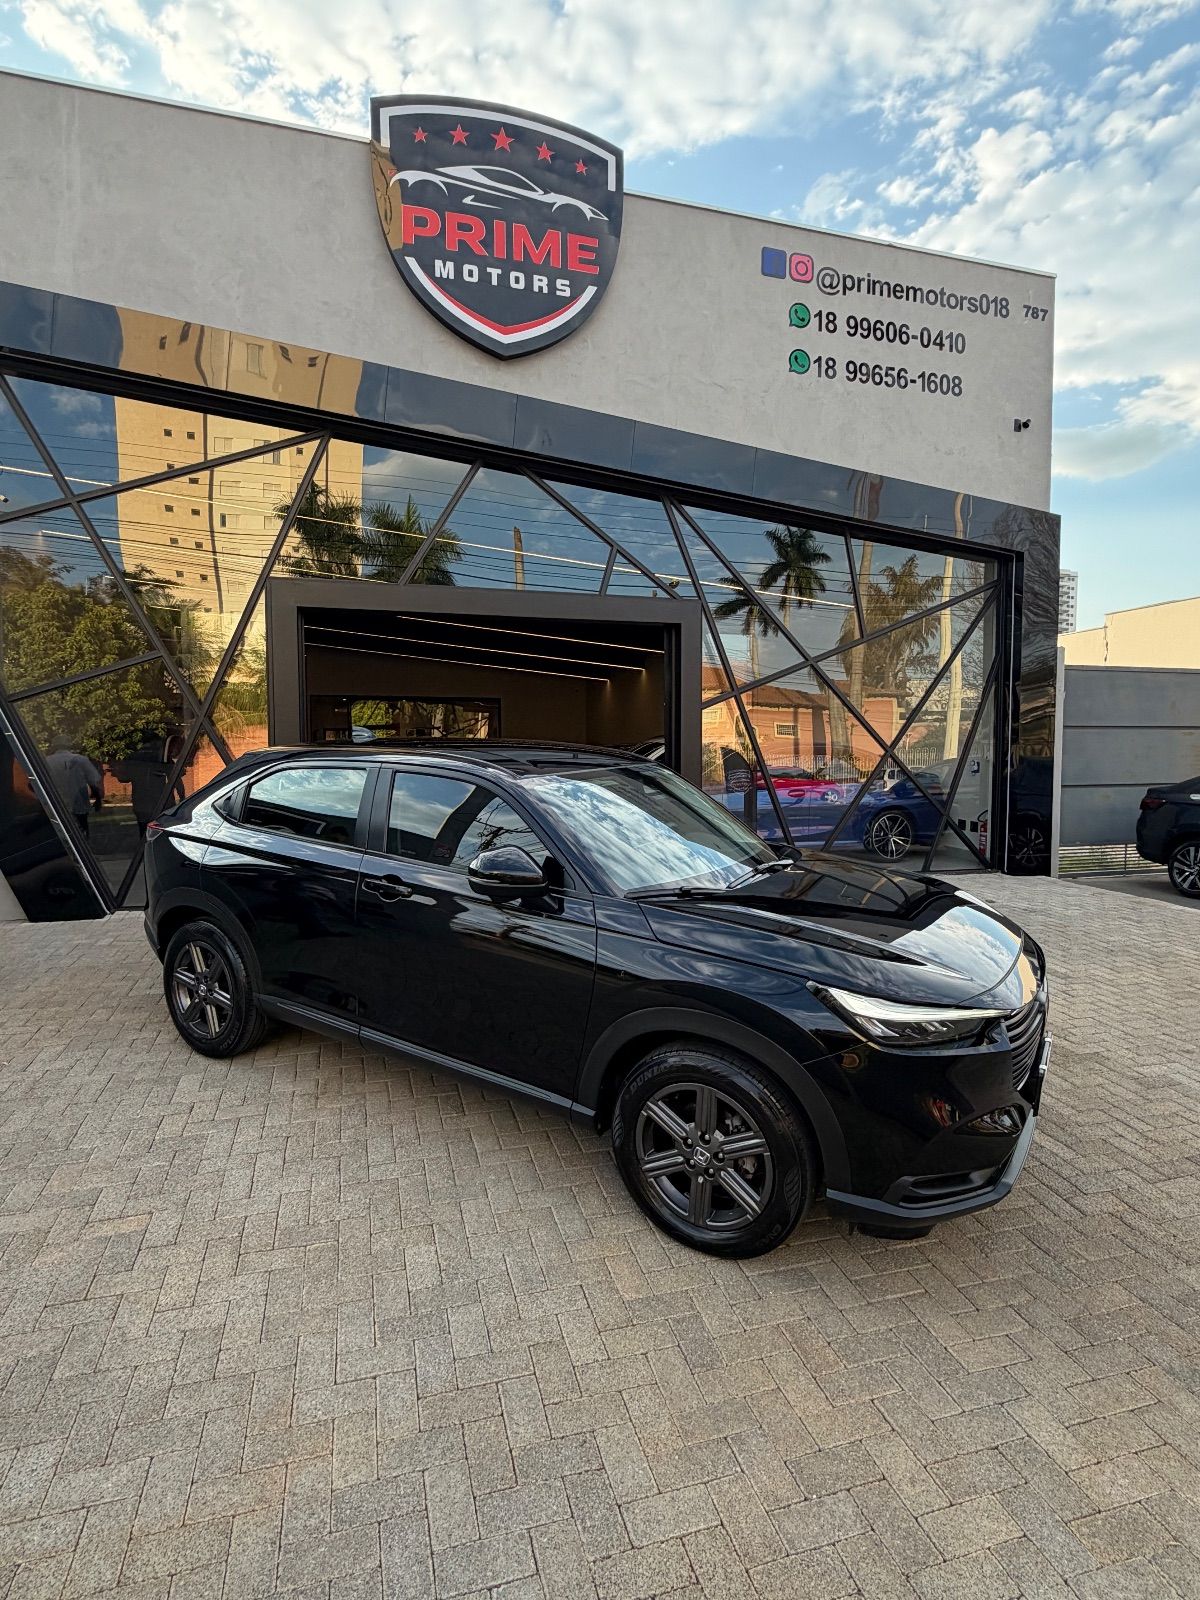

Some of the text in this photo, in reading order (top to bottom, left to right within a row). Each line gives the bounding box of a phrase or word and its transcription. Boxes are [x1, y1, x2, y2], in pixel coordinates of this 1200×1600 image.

[401, 204, 599, 275] PRIME
[434, 260, 571, 297] MOTORS
[816, 267, 1010, 318] @primemotors018
[813, 310, 966, 354] 18 99606-0410
[1023, 304, 1048, 321] 787
[813, 355, 963, 397] 18 99656-1608
